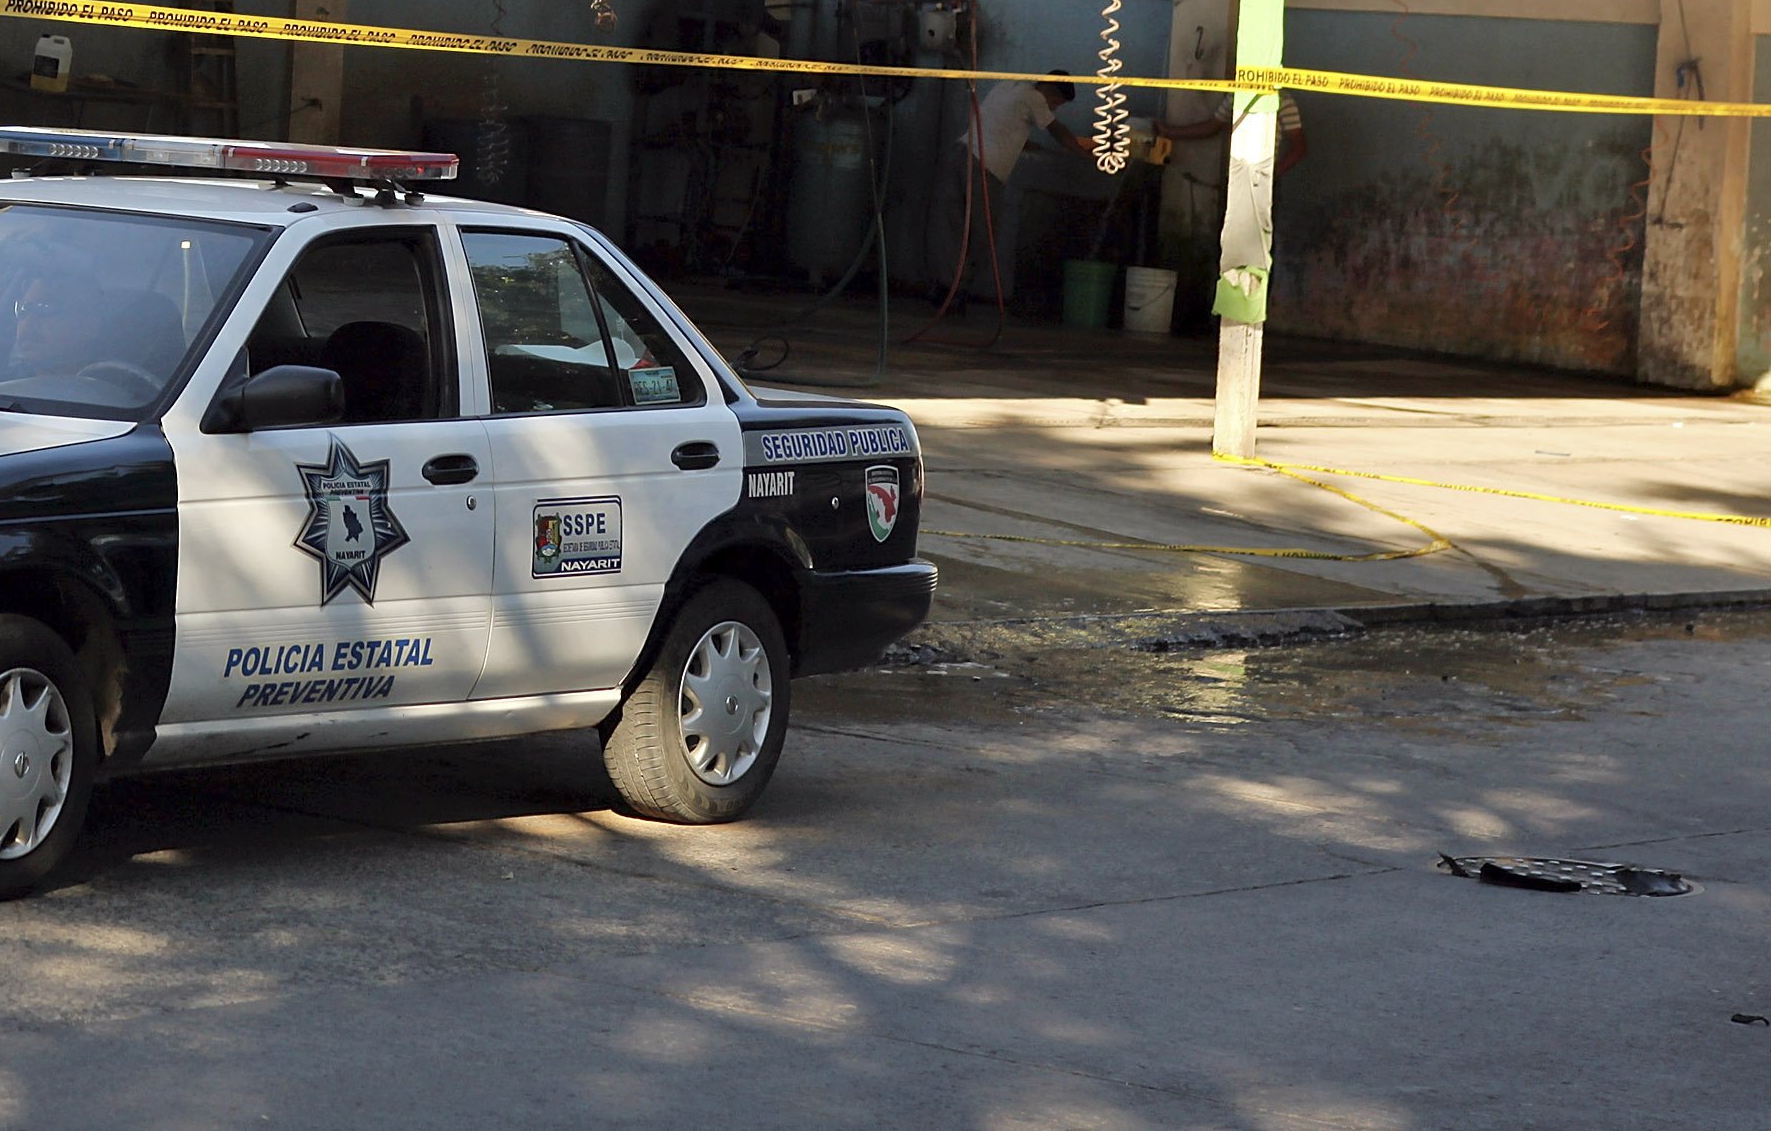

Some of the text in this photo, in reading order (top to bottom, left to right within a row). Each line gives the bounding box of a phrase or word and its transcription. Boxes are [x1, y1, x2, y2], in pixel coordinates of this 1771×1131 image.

[79, 4, 95, 19] EL
[97, 6, 134, 23] PASO
[762, 427, 909, 461] SEGURIDAD PUBLICA
[323, 481, 346, 489] POLICIA
[748, 472, 795, 497] NAYARIT
[563, 512, 606, 536] SSPE
[335, 550, 366, 560] NAYARIT
[561, 558, 621, 571] NAYARIT
[223, 638, 434, 678] POLICIA ESTATAL
[236, 675, 395, 708] PREVENTIVA
